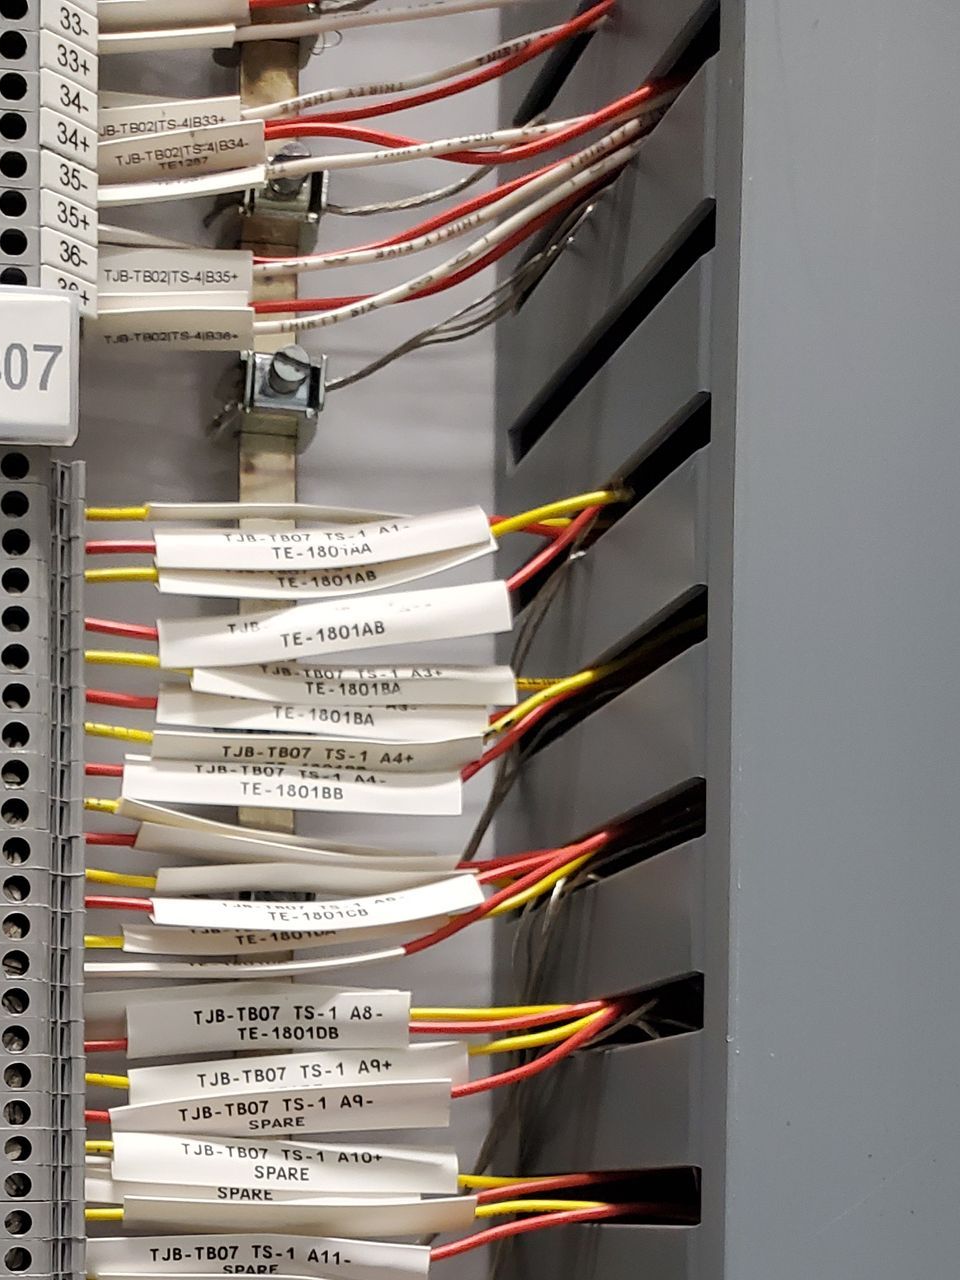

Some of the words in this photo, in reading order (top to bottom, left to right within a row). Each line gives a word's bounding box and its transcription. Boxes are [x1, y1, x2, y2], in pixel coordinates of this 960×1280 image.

[60, 6, 88, 36] 33-
[57, 46, 90, 75] 33+
[60, 84, 88, 112] 34-
[57, 122, 90, 151] 34+
[60, 165, 87, 191] 35-
[57, 201, 89, 230] 35+
[60, 241, 87, 267] 36-
[277, 571, 377, 588] TE-1801AB
[281, 621, 386, 648] TE-1801AB
[222, 746, 311, 759] TJB-TB07
[326, 749, 367, 762] TS-1
[380, 753, 414, 764] A4+
[240, 782, 344, 799] TE-1801BB
[194, 1006, 280, 1025] TJB-TB07
[294, 1006, 337, 1020] TS-1
[350, 1006, 383, 1020] A8-
[237, 1026, 339, 1041] TE-1801DB
[197, 1066, 286, 1088] TJB-TB07
[300, 1063, 344, 1079] TS-1
[358, 1059, 392, 1074] A9+
[179, 1101, 269, 1122] TJB-TB07
[283, 1097, 327, 1112] TS-1
[340, 1095, 373, 1109] A9-
[248, 1117, 305, 1130] SPARE
[182, 1143, 268, 1160] TJB-TB07
[283, 1150, 324, 1162] TS-1
[338, 1152, 382, 1164] A10+
[254, 1165, 310, 1181] SPARE
[150, 1245, 239, 1262] TJB-TB07
[252, 1245, 295, 1260] TS-1
[308, 1250, 352, 1266] A11-
